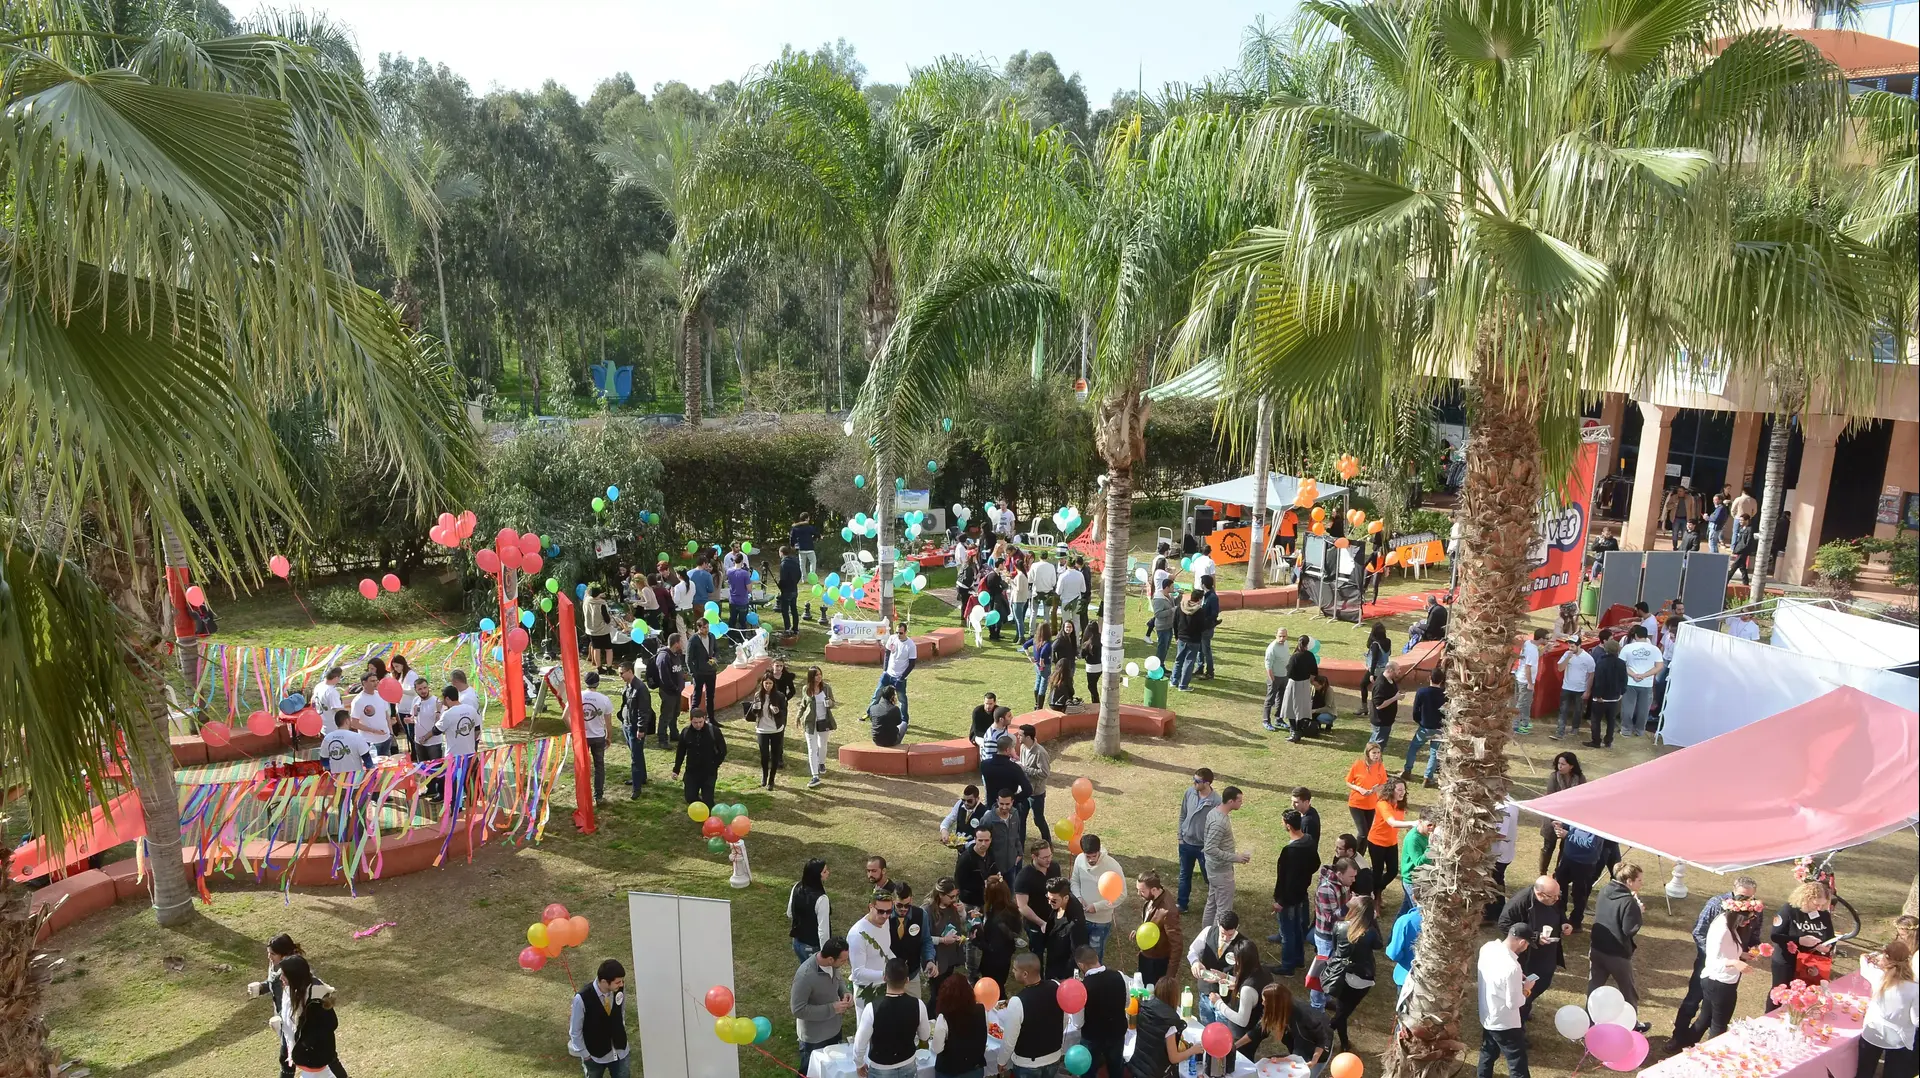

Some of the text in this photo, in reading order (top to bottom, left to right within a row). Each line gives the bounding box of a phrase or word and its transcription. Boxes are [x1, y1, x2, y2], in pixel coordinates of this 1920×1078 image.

[1533, 577, 1549, 590] Can
[1550, 574, 1560, 587] Do
[1561, 572, 1569, 585] It
